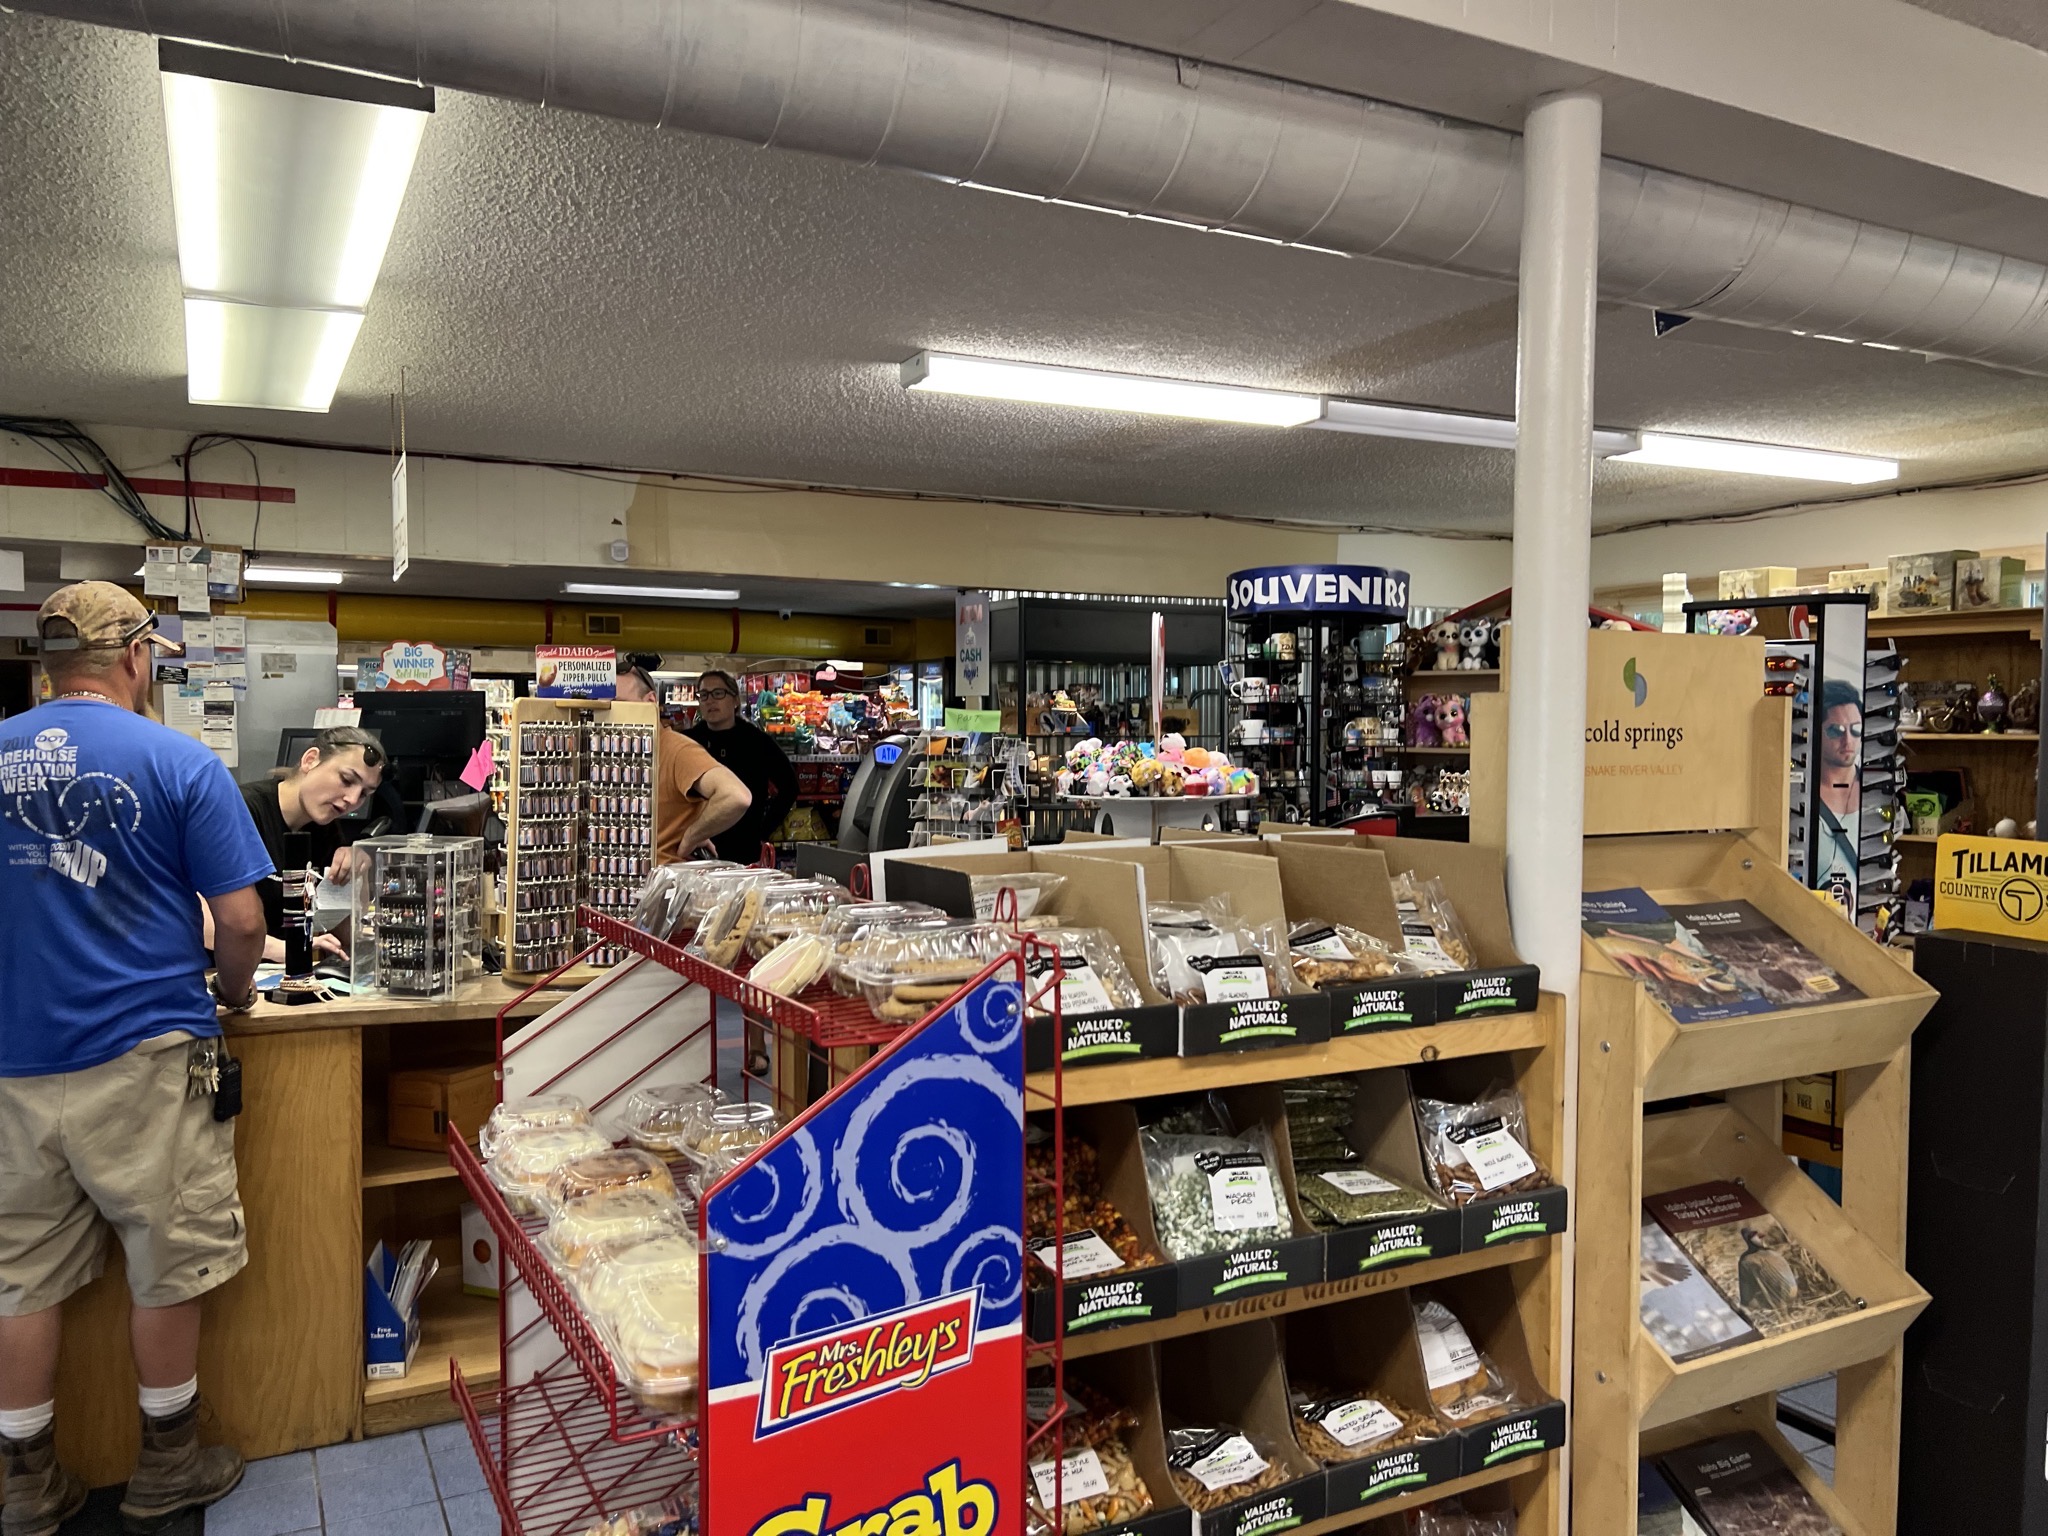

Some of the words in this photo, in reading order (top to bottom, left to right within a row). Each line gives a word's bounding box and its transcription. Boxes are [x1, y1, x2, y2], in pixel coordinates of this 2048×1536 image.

[1230, 574, 1405, 610] SOUVENIRS
[960, 604, 982, 624] ATM
[404, 647, 422, 657] BIG
[537, 648, 558, 658] World
[559, 647, 594, 656] IDAHO
[960, 648, 982, 662] CASH
[393, 658, 435, 669] WINNER
[558, 662, 612, 671] PERSONALIZED
[396, 669, 411, 679] Sold
[562, 673, 606, 682] ZIPPER-PULLS
[36, 735, 68, 744] DOT
[1585, 720, 1620, 742] cold
[1624, 722, 1684, 750] springs
[882, 747, 896, 760] ATM
[0, 763, 76, 780] RECIATION
[1585, 766, 1616, 776] SNAKE
[1620, 765, 1648, 776] RIVER
[1650, 764, 1684, 776] VALLEY
[2, 776, 48, 794] WEEK
[70, 840, 107, 888] UP
[1952, 848, 2048, 880] TILLAM
[1940, 881, 1998, 900] COUNTRY
[1471, 977, 1506, 990] VALUED
[1359, 990, 1398, 1004] VALUED
[1464, 986, 1512, 1003] NATURALS
[1237, 1001, 1280, 1014] VALUED
[1352, 1001, 1405, 1018] NATURALS
[1077, 1019, 1124, 1034] VALUED
[1229, 1013, 1288, 1030] NATURALS
[1067, 1030, 1132, 1051] NATURALS
[1225, 1192, 1256, 1200] WASABI
[1498, 1202, 1534, 1218] VALUED
[1492, 1212, 1540, 1232] NATURALS
[1377, 1224, 1417, 1240] VALUED
[1370, 1236, 1422, 1258] NATURALS
[1230, 1248, 1272, 1266] VALUED
[1223, 1260, 1280, 1282] NATURALS
[1087, 1281, 1135, 1299] VALUED
[1078, 1292, 1143, 1317] NATURALS
[819, 1340, 862, 1366] Mrs.
[779, 1318, 961, 1418] Freshley's
[1333, 1420, 1358, 1434] SALTED
[1496, 1420, 1532, 1437] VALUED
[1490, 1429, 1538, 1453] NATURALS
[1070, 1458, 1090, 1468] STYLE
[1376, 1452, 1414, 1471] VALUED
[1369, 1463, 1420, 1487] NATURALS
[1244, 1498, 1286, 1520] VALUED
[1236, 1507, 1293, 1536] NATURALS
